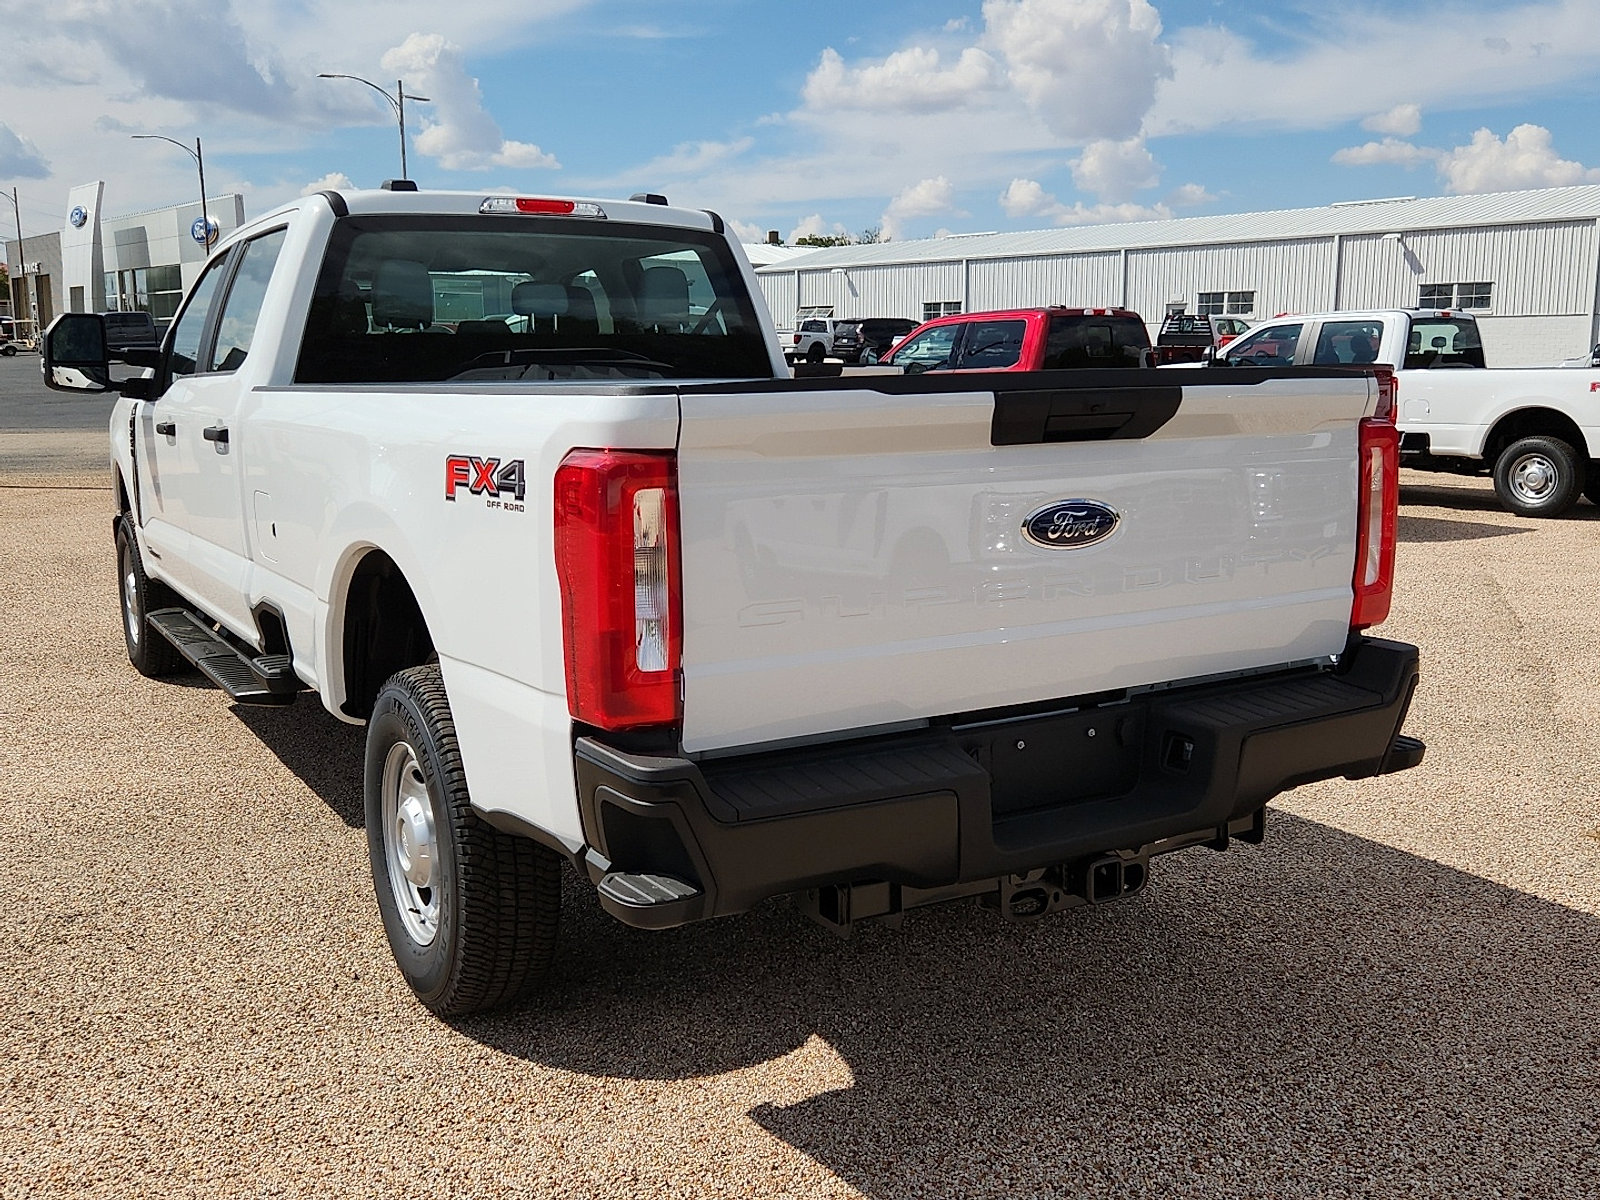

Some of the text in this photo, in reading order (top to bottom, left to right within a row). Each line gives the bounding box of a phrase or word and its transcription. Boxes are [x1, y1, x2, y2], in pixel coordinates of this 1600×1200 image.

[444, 453, 526, 502] FX4
[486, 500, 525, 513] OFF ROAD
[1047, 510, 1099, 540] Ford
[737, 545, 1334, 628] SUPER DUTY
